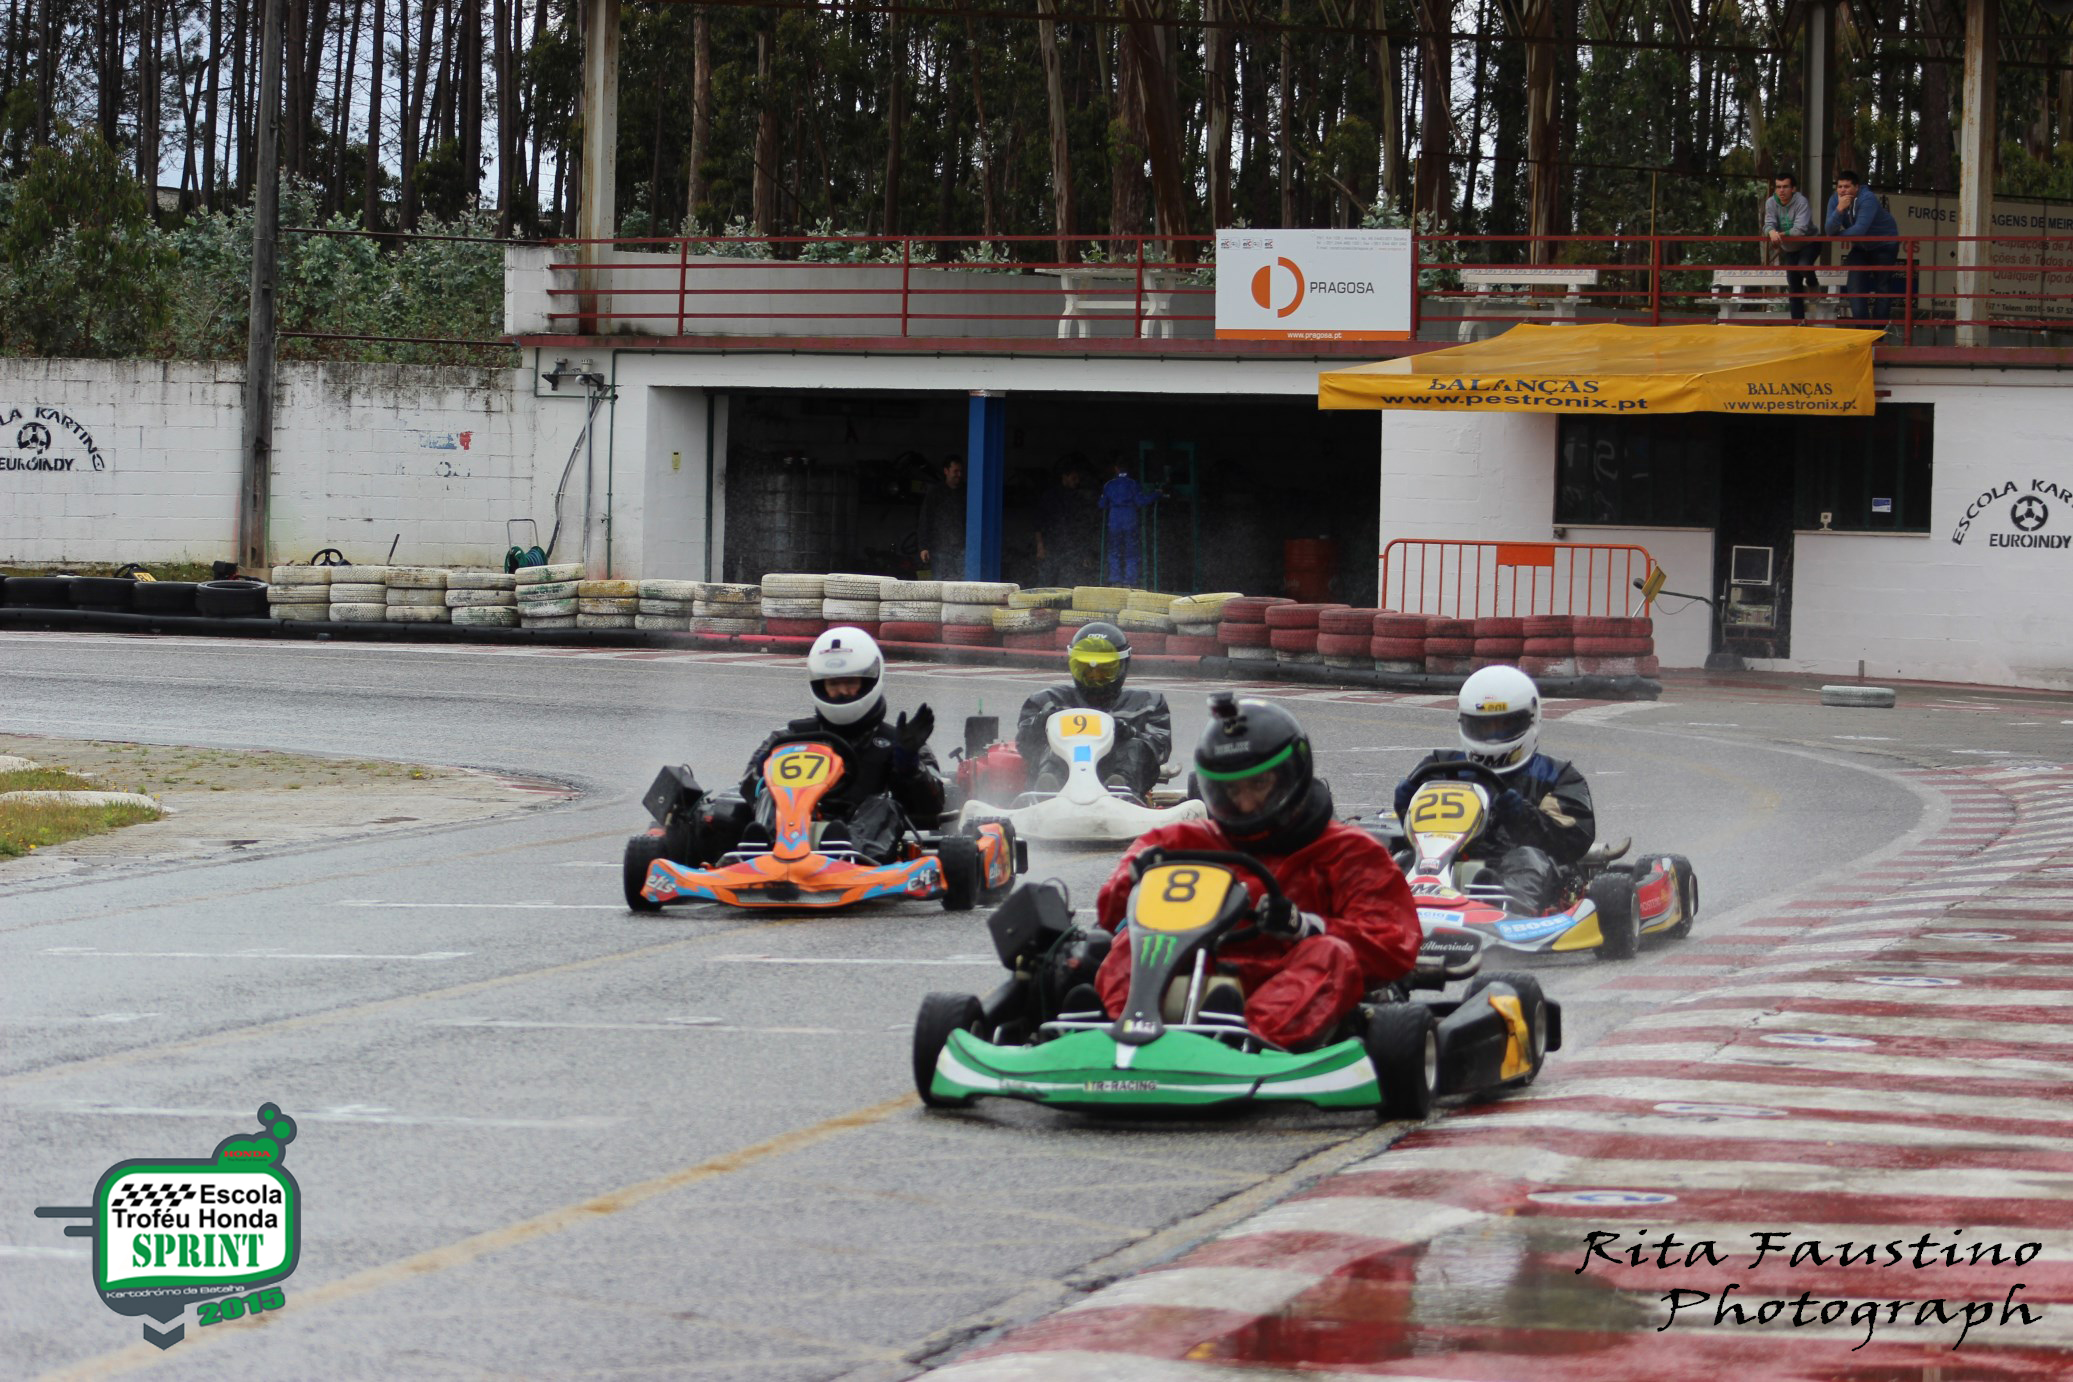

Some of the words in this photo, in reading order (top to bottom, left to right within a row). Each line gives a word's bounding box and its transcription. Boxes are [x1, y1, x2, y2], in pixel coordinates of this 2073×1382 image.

[1908, 206, 1946, 221] FUROS
[1949, 211, 1956, 222] E
[1992, 214, 2028, 227] AGENS
[2048, 217, 2073, 230] MEIR
[1310, 281, 1374, 294] PRAGOSA
[1287, 332, 1342, 340] www.pragosa.pt
[1747, 383, 1833, 398] BALANÇAS
[1380, 393, 1649, 411] www.pestronix.pt
[1951, 481, 2018, 546] ESCOLA
[2031, 478, 2073, 508] KAR
[1989, 533, 2072, 549] EUROINDY
[1072, 715, 1088, 734] 9
[779, 755, 826, 780] 67
[1414, 792, 1465, 824] 25
[1162, 869, 1200, 902] 8
